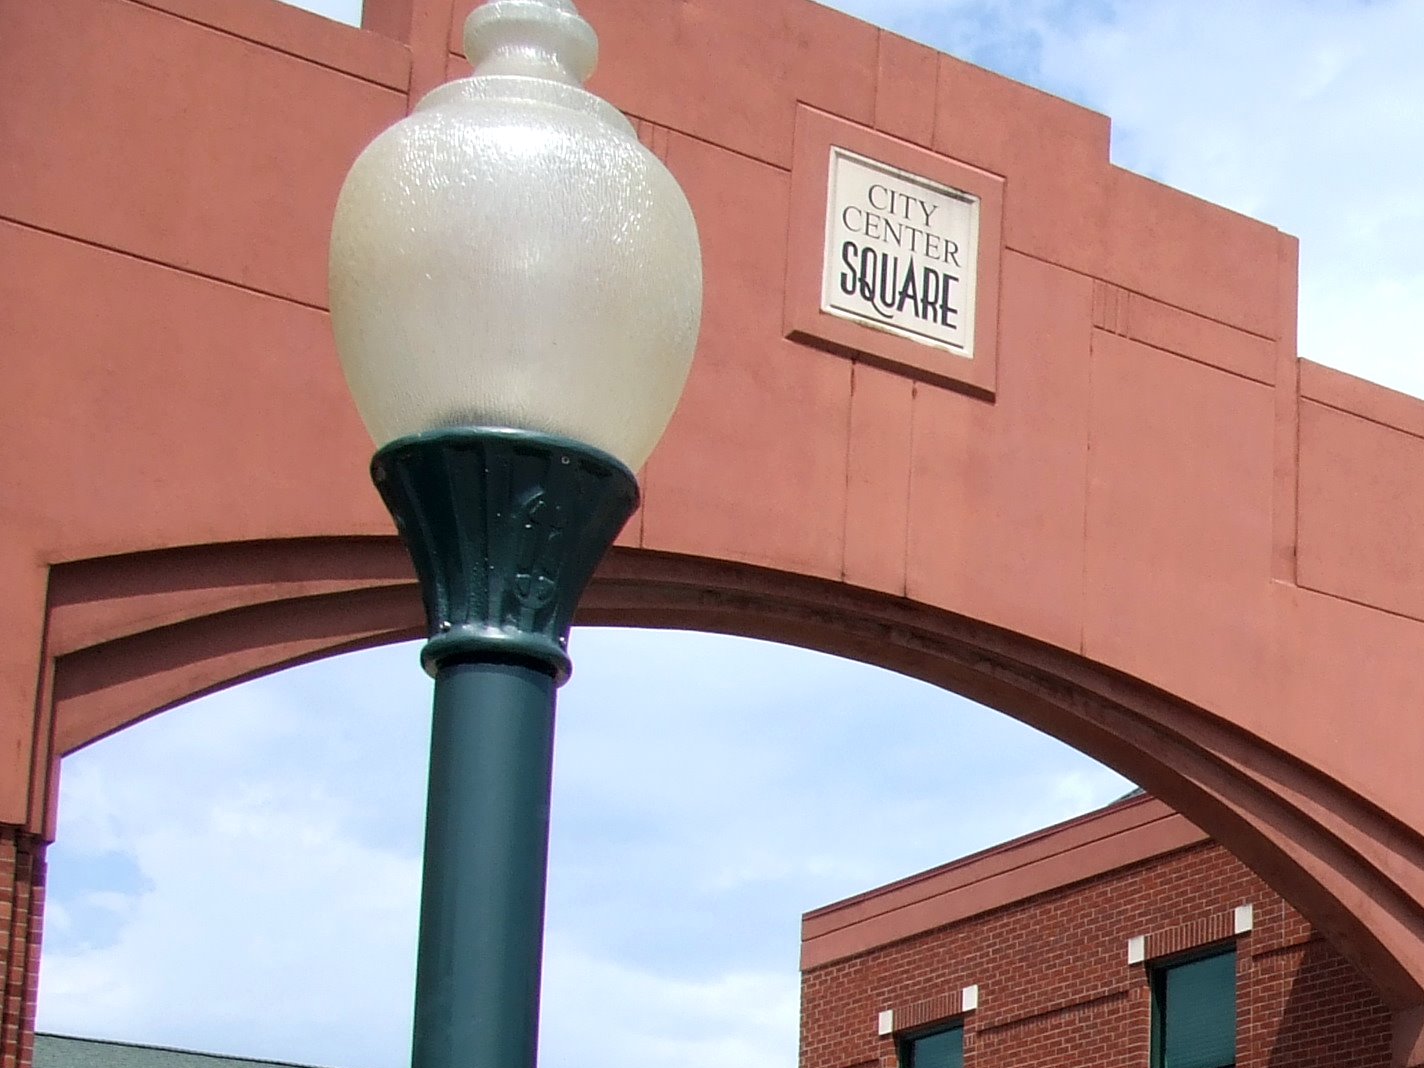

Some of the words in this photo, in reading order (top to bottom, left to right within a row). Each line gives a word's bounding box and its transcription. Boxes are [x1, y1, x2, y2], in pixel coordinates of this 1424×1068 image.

[868, 184, 938, 227] CITY
[842, 206, 962, 268] CENTER
[840, 241, 959, 330] SQUARE
